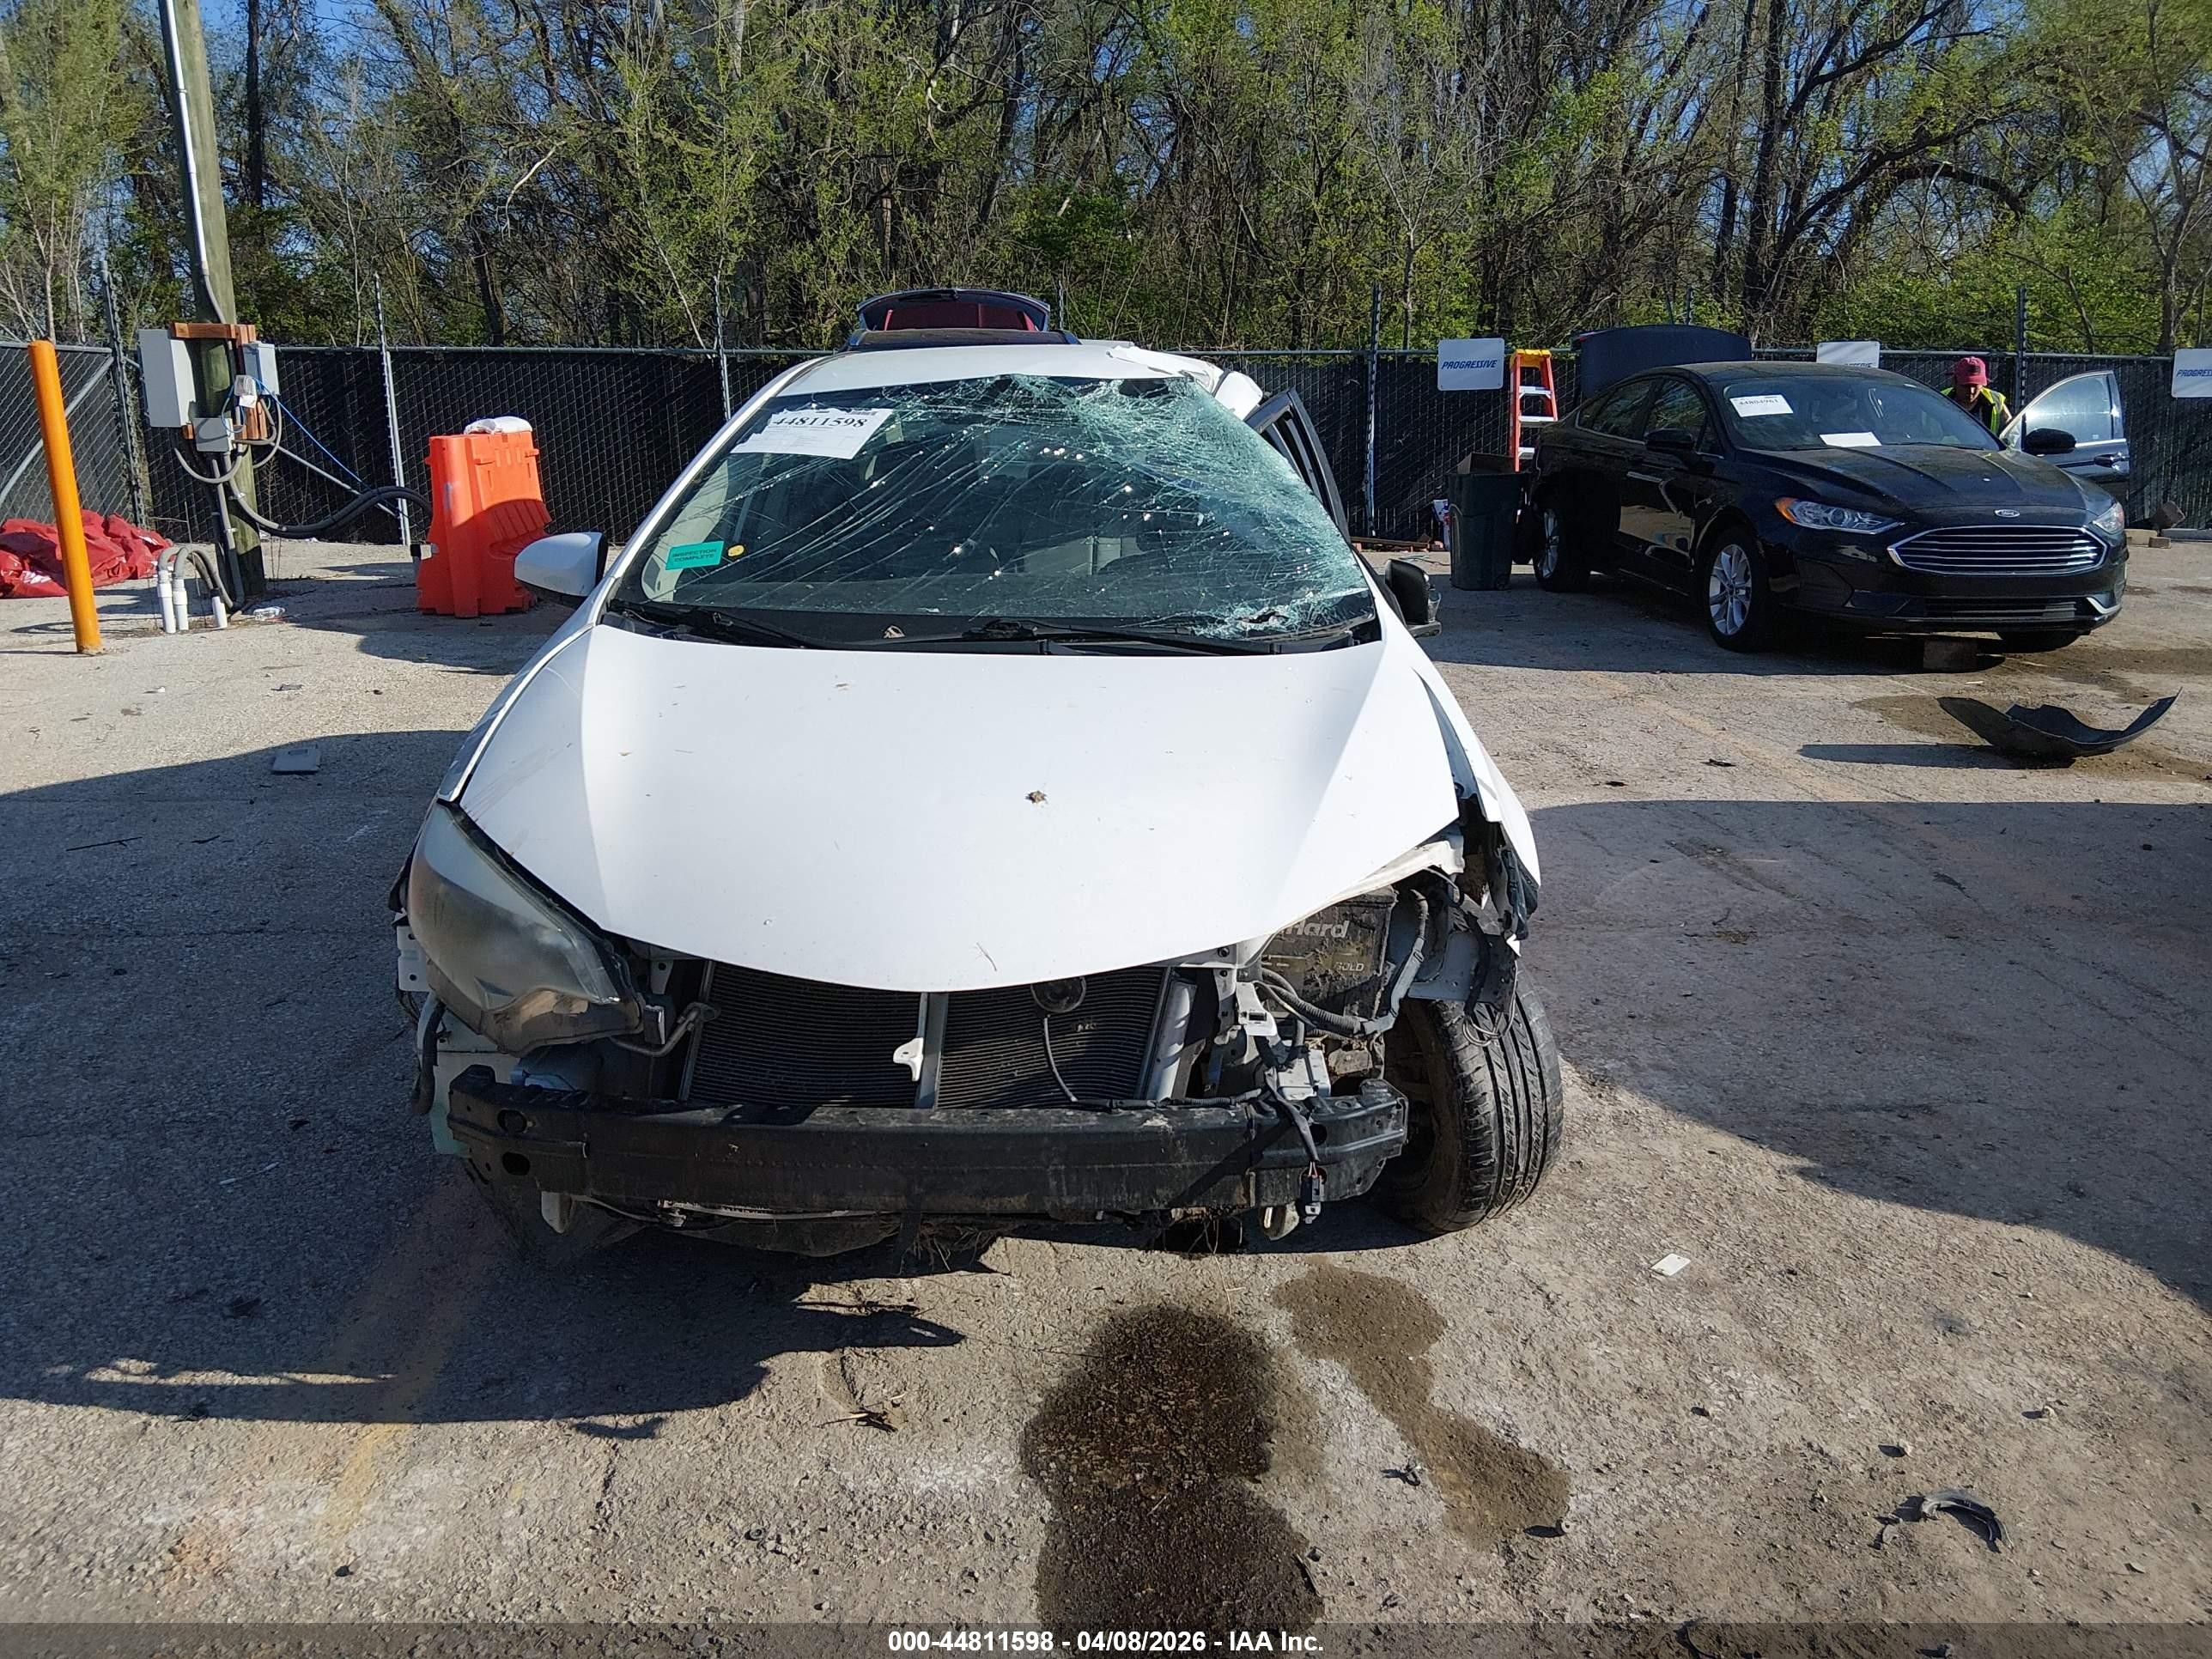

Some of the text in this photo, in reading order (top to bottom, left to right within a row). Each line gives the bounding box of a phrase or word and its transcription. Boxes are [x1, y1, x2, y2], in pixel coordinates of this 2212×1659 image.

[1441, 359, 1498, 369] PROGRESSIVE
[772, 416, 868, 428] 44811598
[672, 549, 717, 558] INSPECTION
[673, 554, 714, 562] COMPLETE
